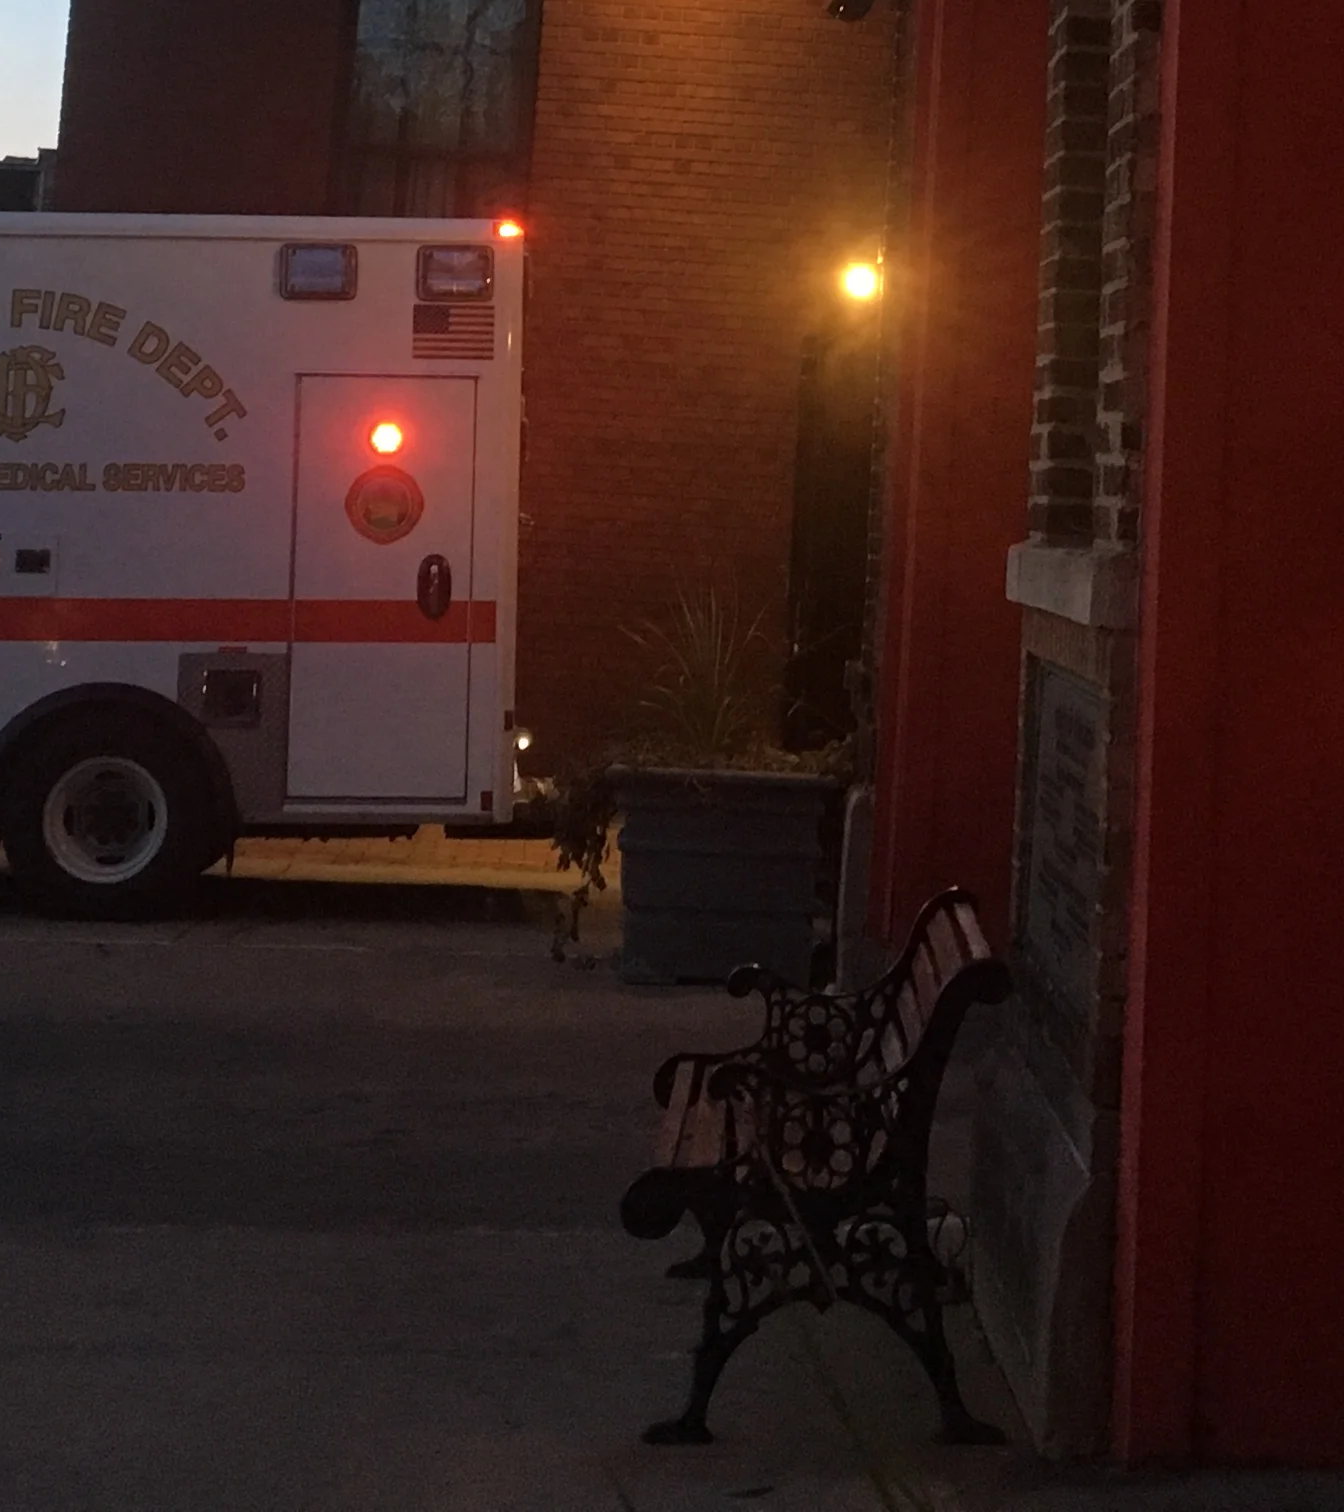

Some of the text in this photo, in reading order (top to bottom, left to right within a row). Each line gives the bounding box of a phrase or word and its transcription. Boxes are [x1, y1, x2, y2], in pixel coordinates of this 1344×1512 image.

[10, 288, 127, 346] FIRE
[127, 321, 247, 442] DEPT.
[102, 463, 246, 493] SERVICES
